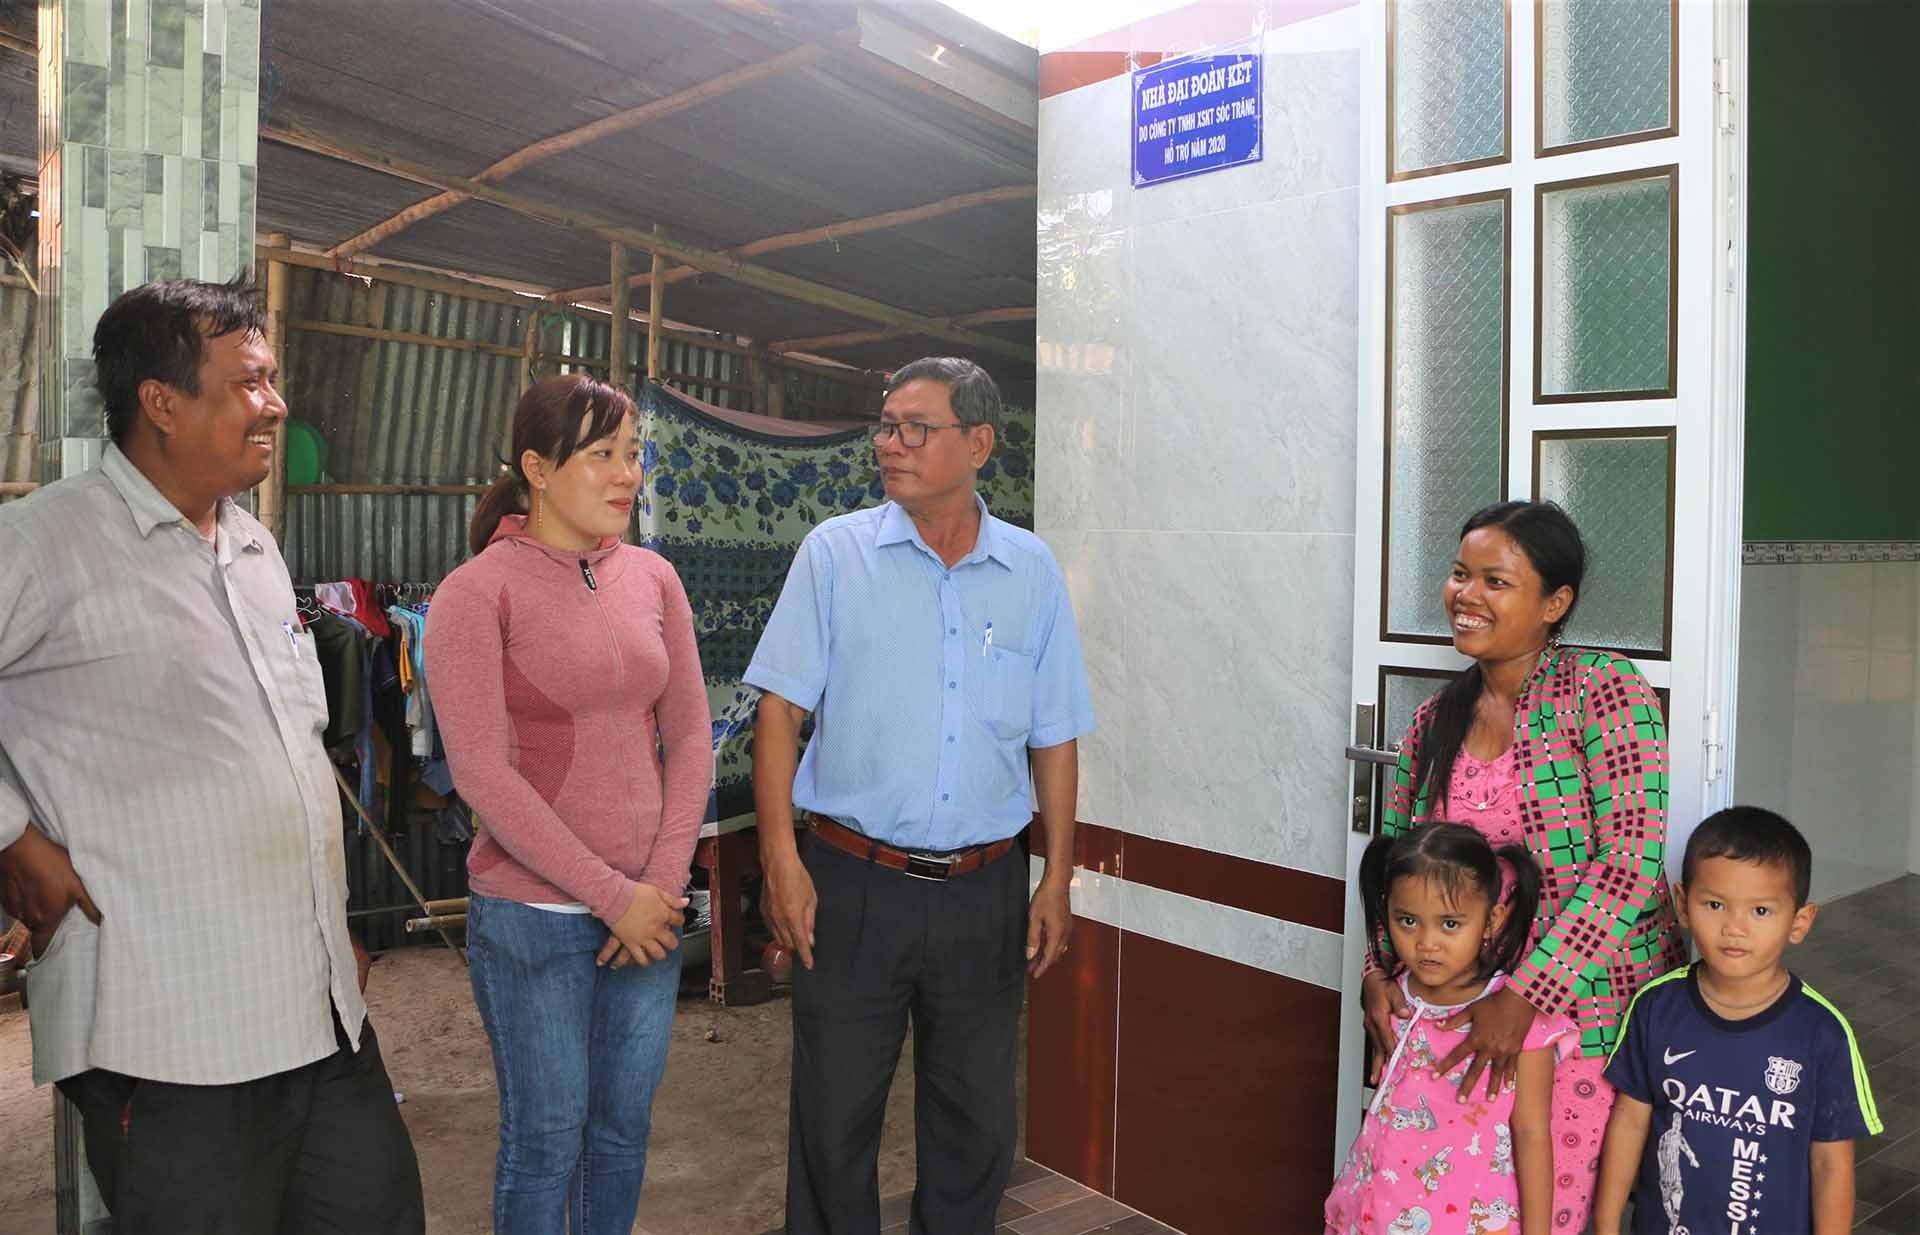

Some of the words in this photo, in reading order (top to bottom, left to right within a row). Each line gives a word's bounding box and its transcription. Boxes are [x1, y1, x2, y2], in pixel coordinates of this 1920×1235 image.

[1142, 80, 1166, 111] NHÀ
[1168, 78, 1189, 106] ĐẠI
[1191, 65, 1225, 97] ĐOÀN
[1139, 126, 1148, 143] DO
[1149, 118, 1167, 140] CÔNG
[1168, 118, 1177, 135] TY
[1178, 112, 1196, 134] TNHH
[1197, 108, 1214, 128] XSKT
[1216, 101, 1231, 124] SÓC
[1231, 97, 1255, 120] TRĂNG
[1175, 142, 1190, 163] TRỢ
[1191, 137, 1207, 158] NĂM
[1208, 134, 1226, 156] 2020
[1662, 1078, 1796, 1129] QATAR
[1683, 1109, 1767, 1136] AIRWAYS
